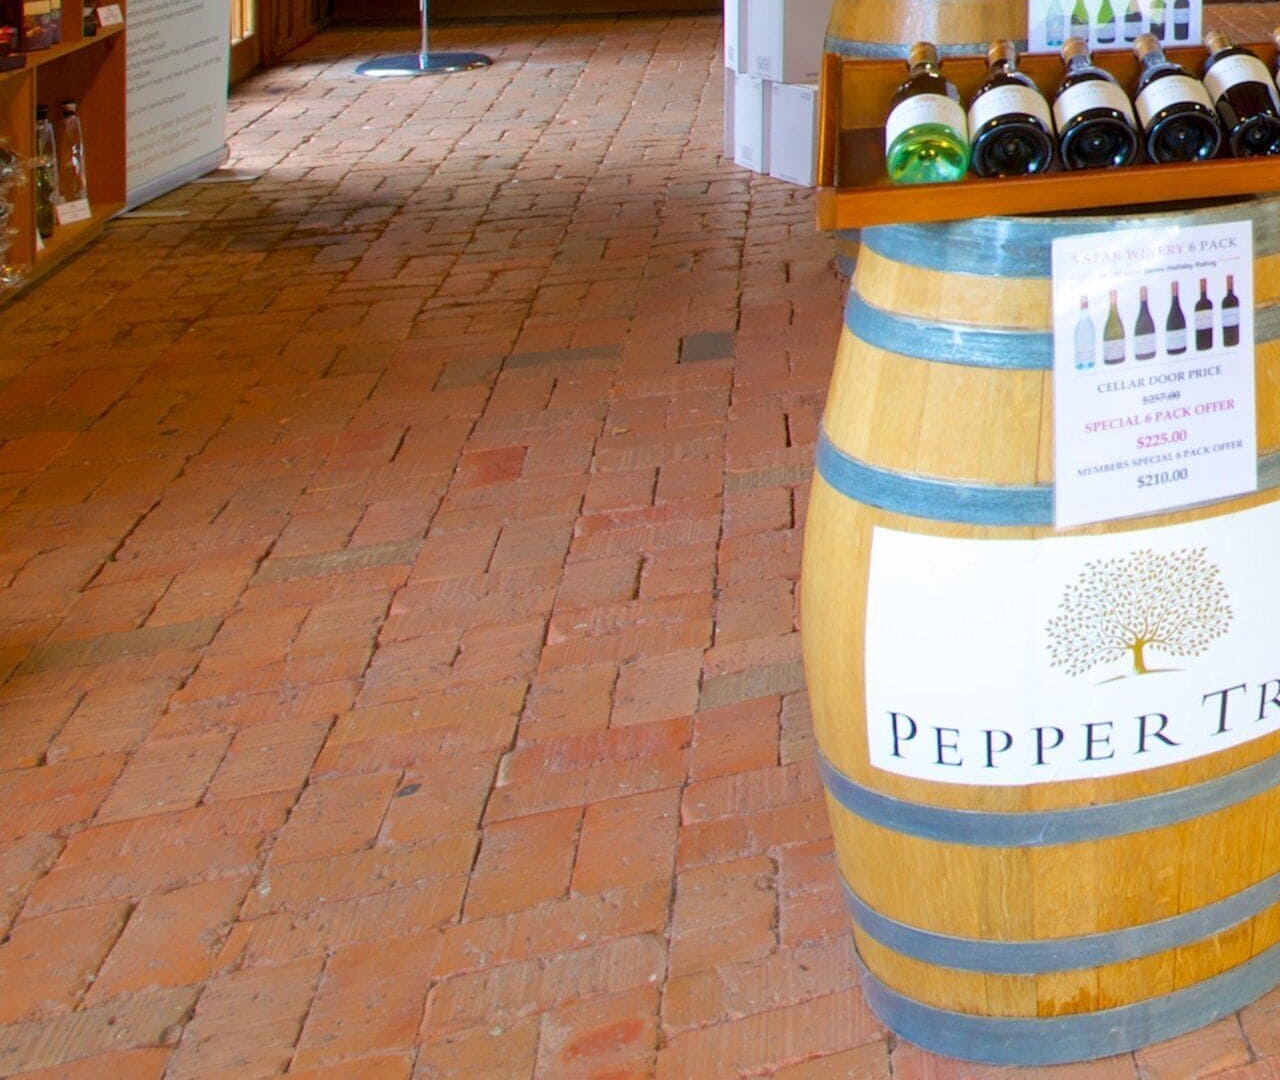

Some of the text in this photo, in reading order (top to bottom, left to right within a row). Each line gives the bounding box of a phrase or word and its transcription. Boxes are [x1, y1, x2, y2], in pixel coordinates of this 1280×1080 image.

[1200, 236, 1239, 252] PACK
[1097, 364, 1223, 394] CELLAR DOOR PRICE
[1084, 398, 1236, 434] SPECIAL 6 PACK OFFER
[1136, 429, 1188, 450] $225.00
[1077, 460, 1129, 477] MEMBERS
[1131, 452, 1174, 468] SPECIAL
[1183, 446, 1212, 458] PACK
[1213, 439, 1244, 453] OFFER
[1136, 468, 1188, 488] $210.00
[886, 710, 1183, 769] PEPPER
